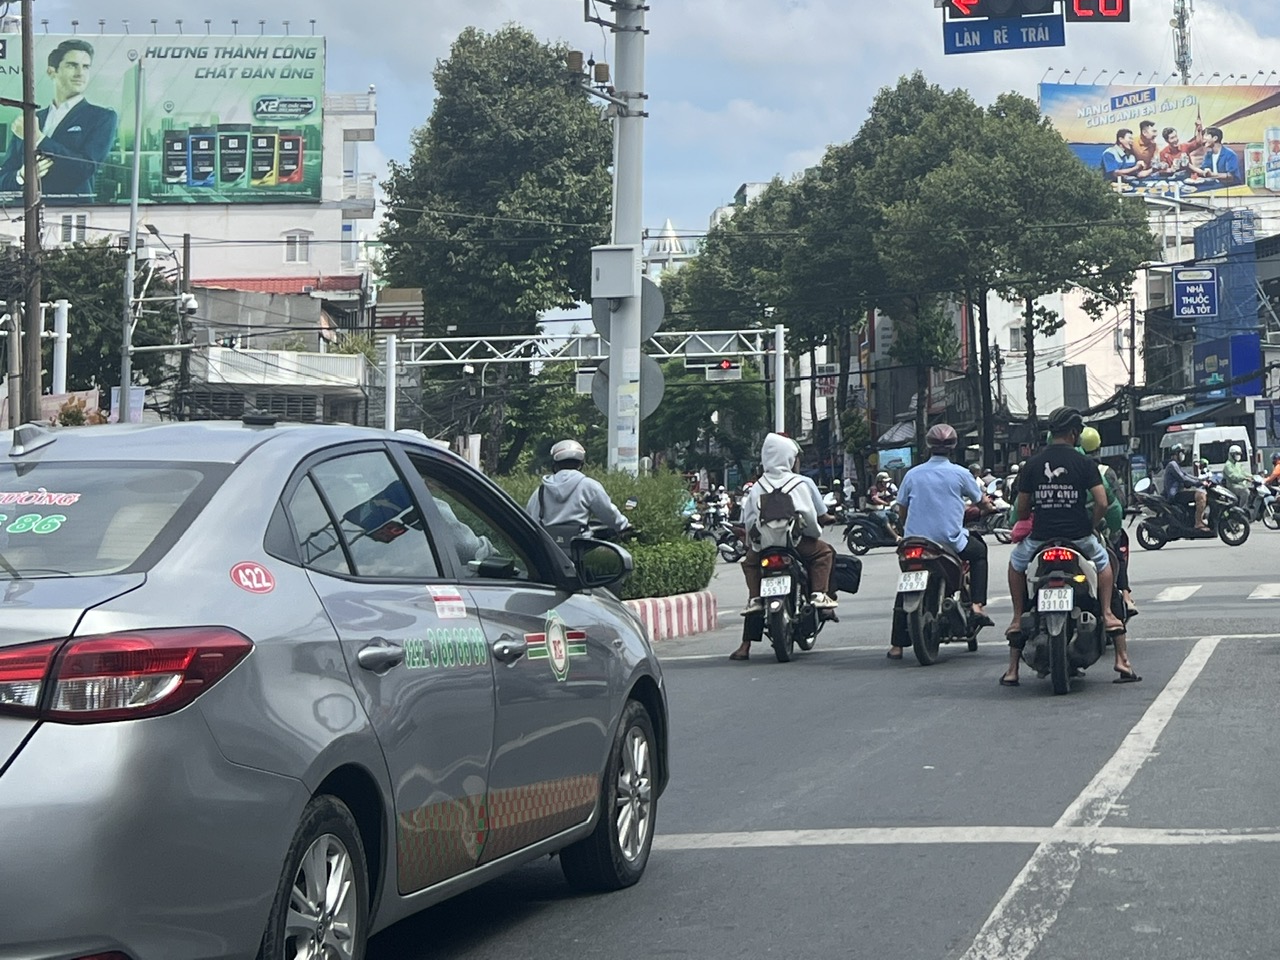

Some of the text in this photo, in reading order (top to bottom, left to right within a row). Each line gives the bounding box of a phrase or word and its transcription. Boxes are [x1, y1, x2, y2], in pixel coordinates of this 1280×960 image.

[955, 23, 1049, 47] LÀN RẼ TRÁI
[214, 43, 268, 59] THÀNH
[272, 43, 317, 59] CÔNG
[194, 62, 238, 79] CHẤT
[280, 64, 315, 79] ÔNG
[257, 99, 278, 112] X2
[1115, 91, 1151, 108] LARUE
[1117, 109, 1140, 122] ANH
[1141, 105, 1157, 117] EM
[1186, 283, 1204, 293] NHÀ
[1181, 293, 1209, 304] THUỐC
[1181, 303, 1211, 314] GIÁ TỐT
[1057, 490, 1078, 499] ANH
[6, 514, 67, 534] 86
[238, 567, 272, 589] 422
[1041, 600, 1071, 610] 331.01
